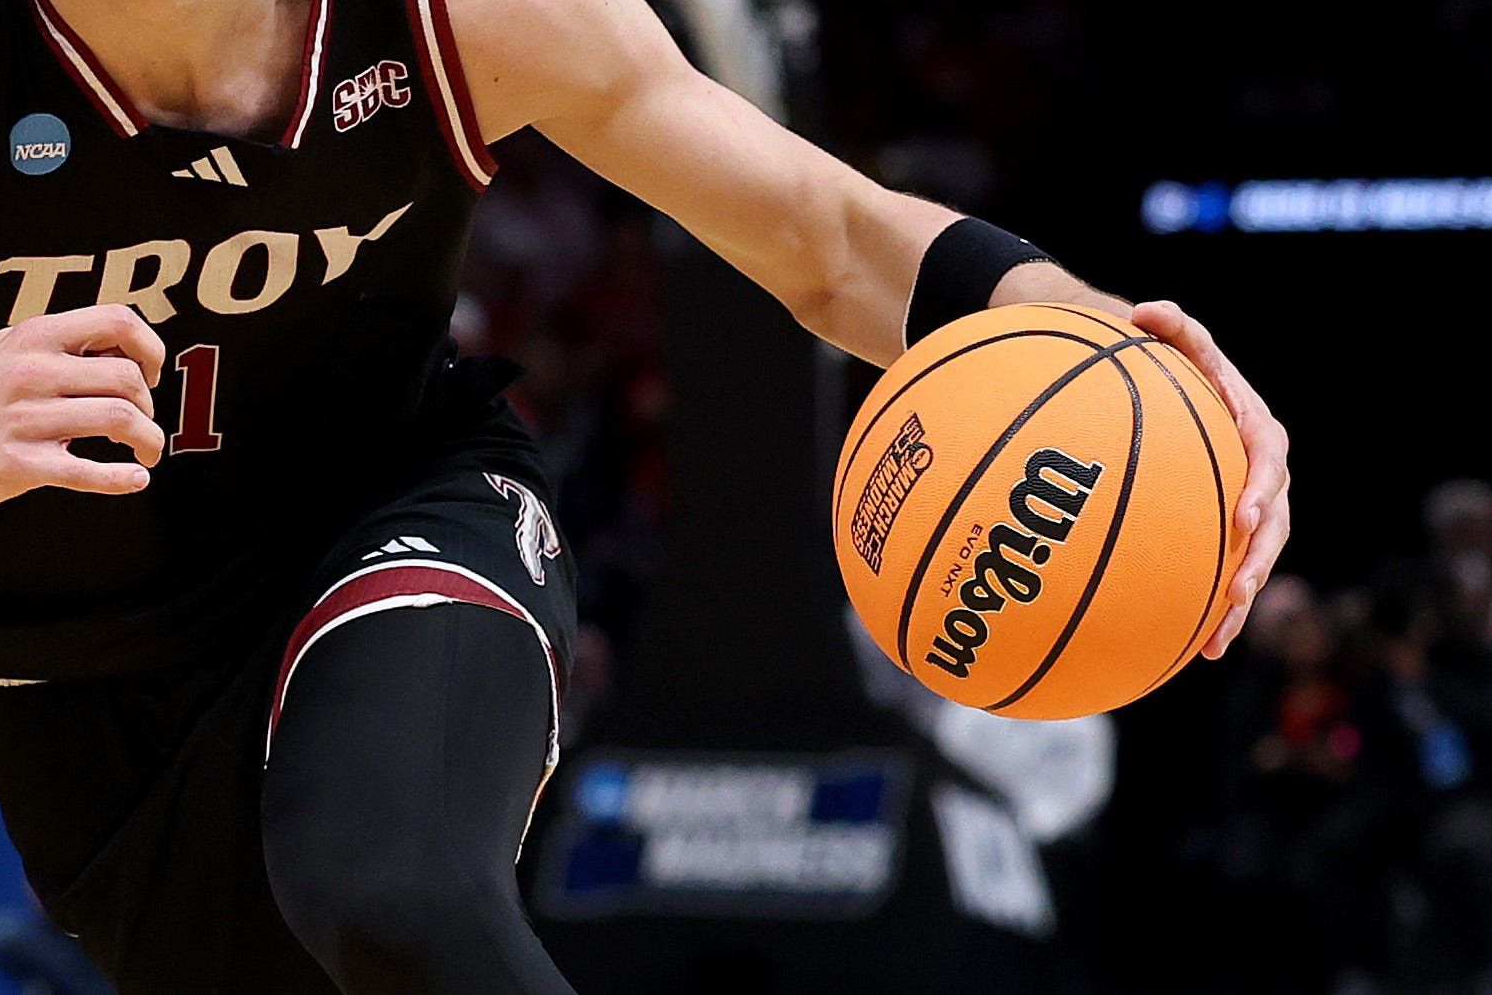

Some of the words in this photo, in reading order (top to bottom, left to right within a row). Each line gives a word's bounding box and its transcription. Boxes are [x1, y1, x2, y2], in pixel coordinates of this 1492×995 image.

[333, 60, 411, 132] SBC
[14, 142, 66, 162] NCAA
[854, 454, 900, 551] MADNESS
[873, 461, 918, 539] MARCH
[925, 447, 1106, 678] Wilson
[958, 523, 983, 560] EVO
[940, 562, 963, 598] NXT
